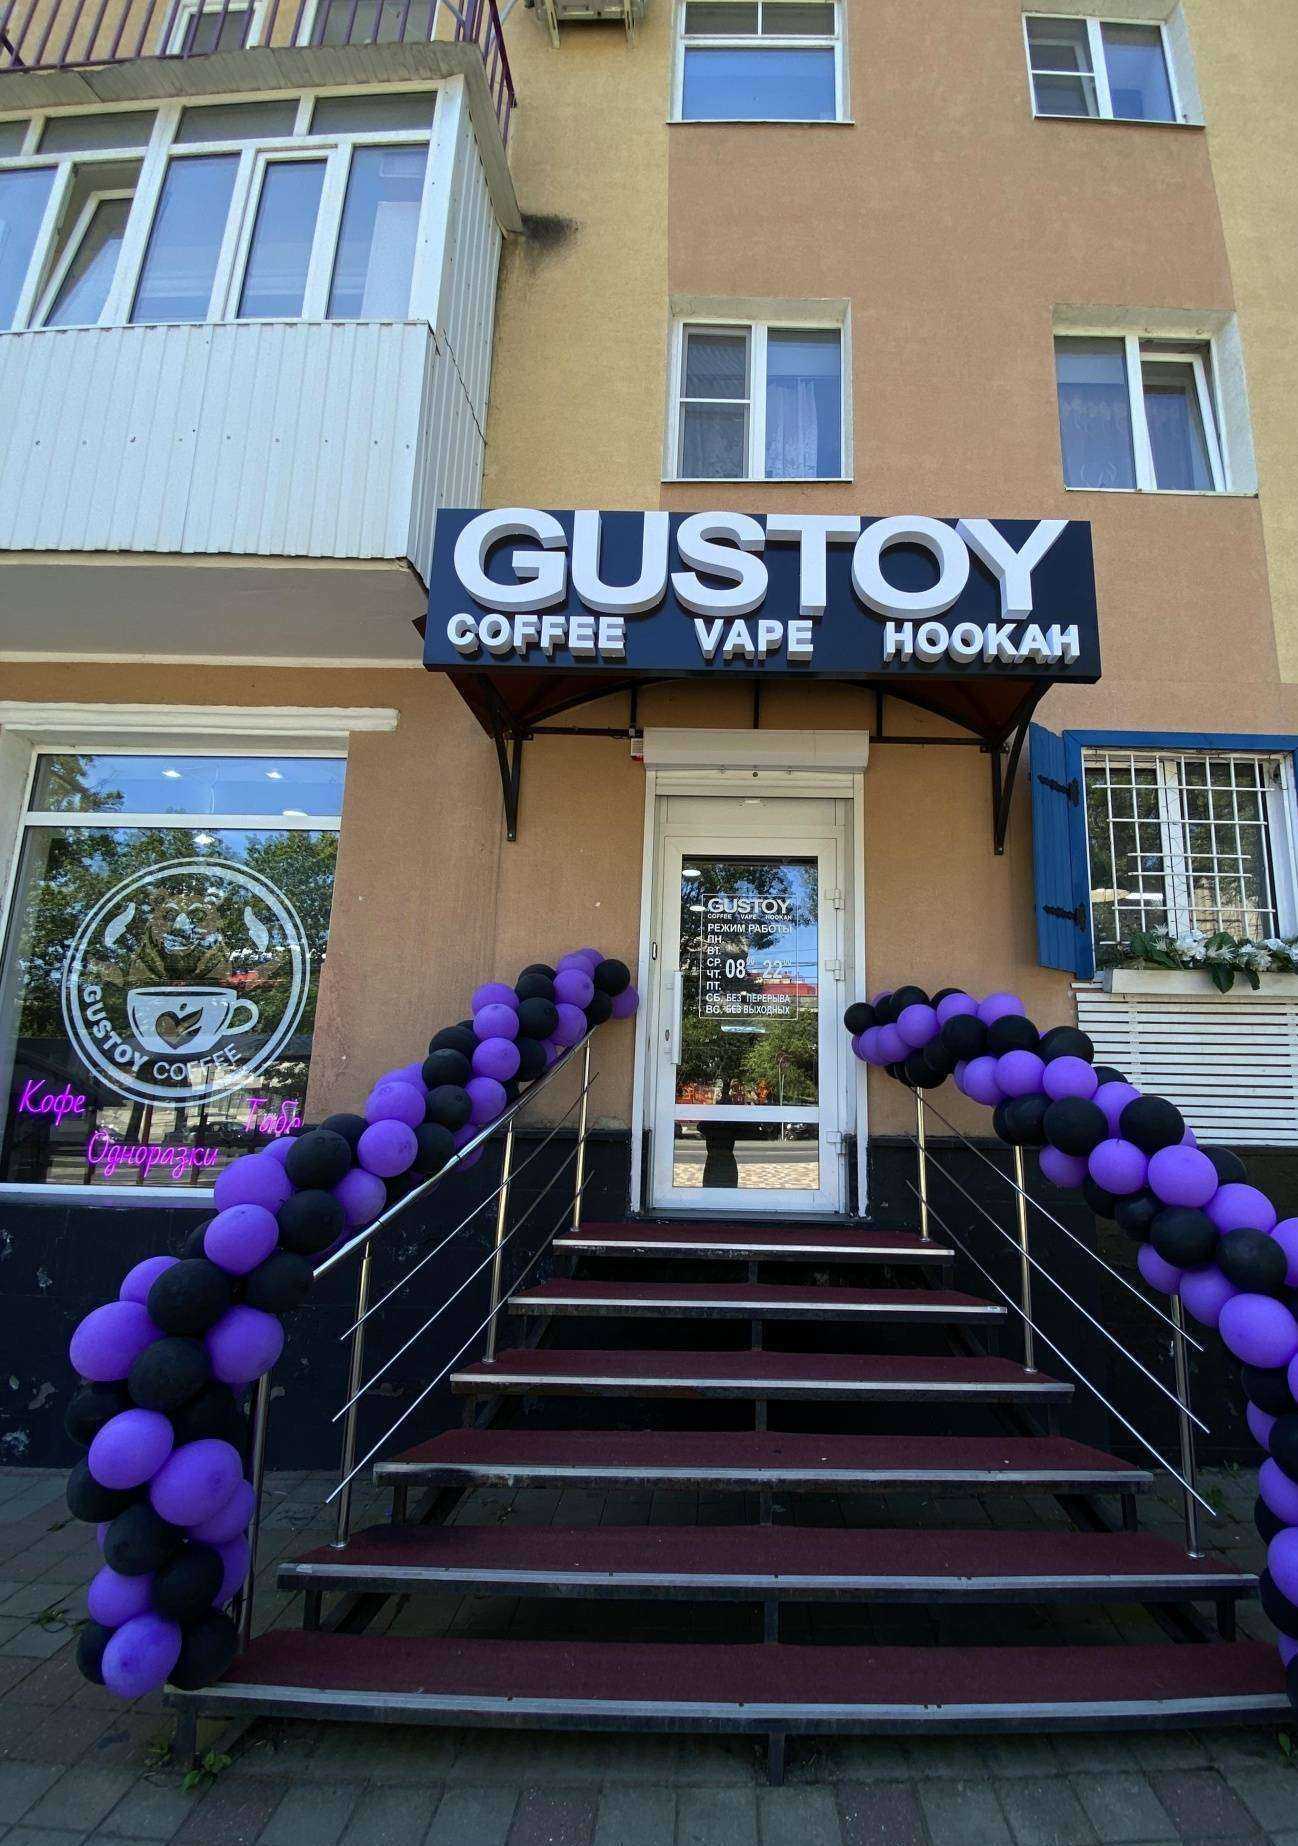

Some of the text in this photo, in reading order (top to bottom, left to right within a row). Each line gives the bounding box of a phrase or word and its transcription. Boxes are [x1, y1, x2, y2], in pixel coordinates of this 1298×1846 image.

[454, 507, 1072, 621] GUSTOY
[447, 613, 1081, 665] COFFEE VAPE HOOKAH
[708, 898, 790, 914] GUSTOY
[708, 923, 792, 934] РЕЖИМ РАБОТЫ
[707, 934, 724, 944] ПН.
[707, 946, 721, 955] ВТ.
[706, 957, 722, 967] СР.
[706, 969, 722, 979] ЧТ.
[706, 981, 722, 991] ПТ.
[706, 993, 790, 1003] СБ. БЕЗ ПЕРЕРЫВА
[726, 1005, 742, 1014] БЕЗ
[743, 1005, 790, 1015] ВЫХОДНЫХ
[83, 985, 243, 1081] GUSTOY COFFEE
[19, 1079, 87, 1127] Кофе
[87, 1129, 220, 1179] Одноразки
